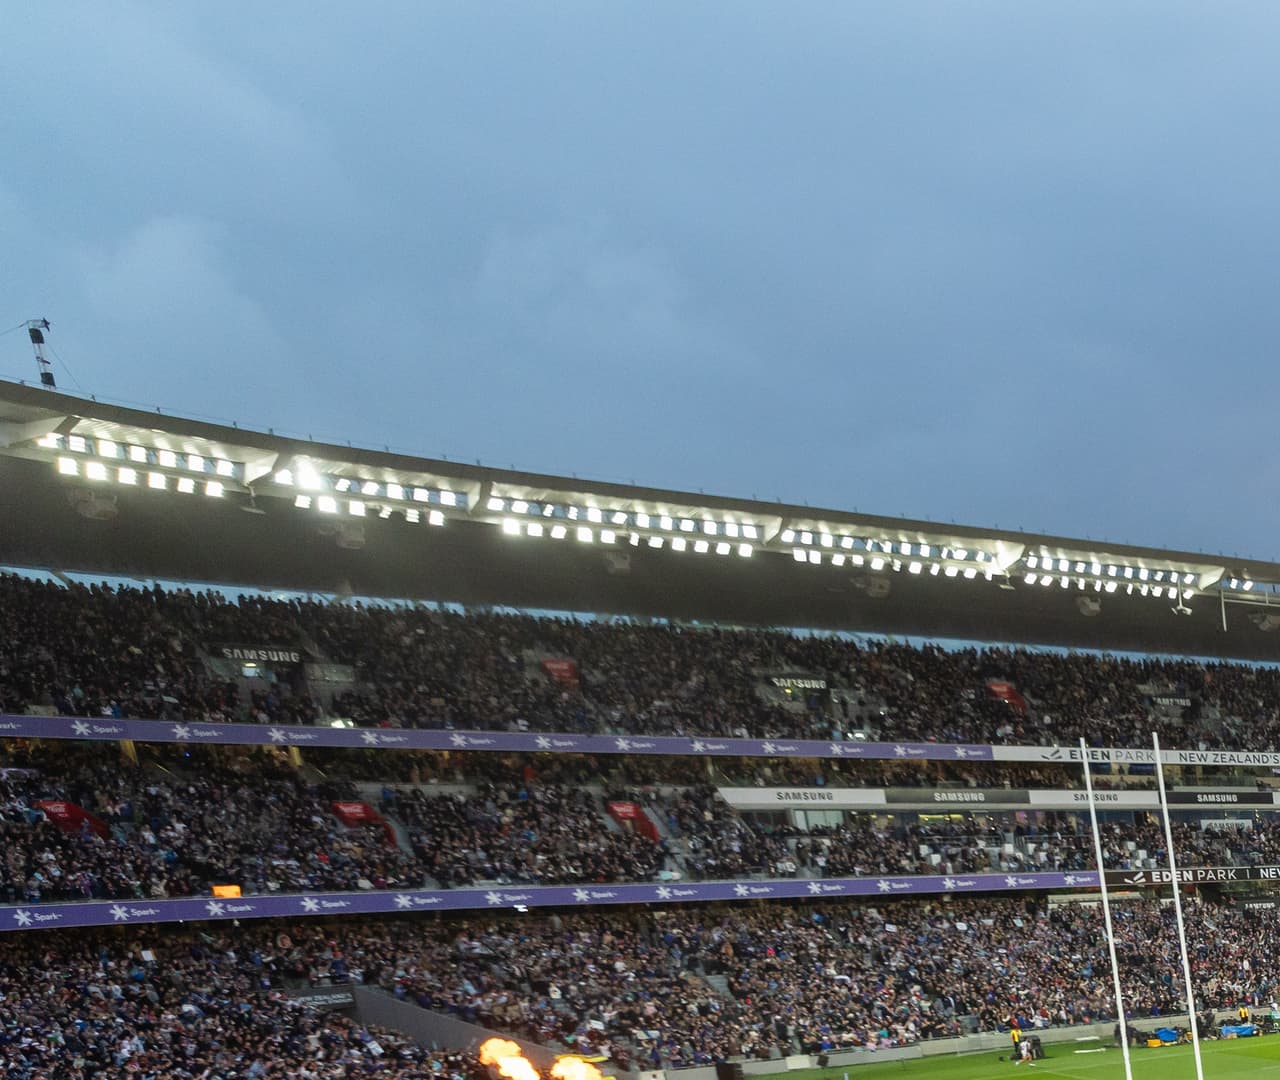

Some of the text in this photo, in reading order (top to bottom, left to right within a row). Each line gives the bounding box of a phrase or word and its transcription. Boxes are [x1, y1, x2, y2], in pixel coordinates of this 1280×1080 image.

[222, 648, 299, 663] SAMSUNG
[1070, 750, 1111, 761] EDEN
[1115, 750, 1155, 762] PARK
[1179, 752, 1208, 763] NEW
[1212, 754, 1280, 765] ZEALAND'S
[776, 792, 834, 801] SAMSUNG
[933, 792, 985, 802] SAMSUNG
[1197, 794, 1238, 803] SAMSUNG
[1197, 870, 1237, 881] PARK
[34, 913, 58, 921] Spark
[131, 908, 156, 917] Spark
